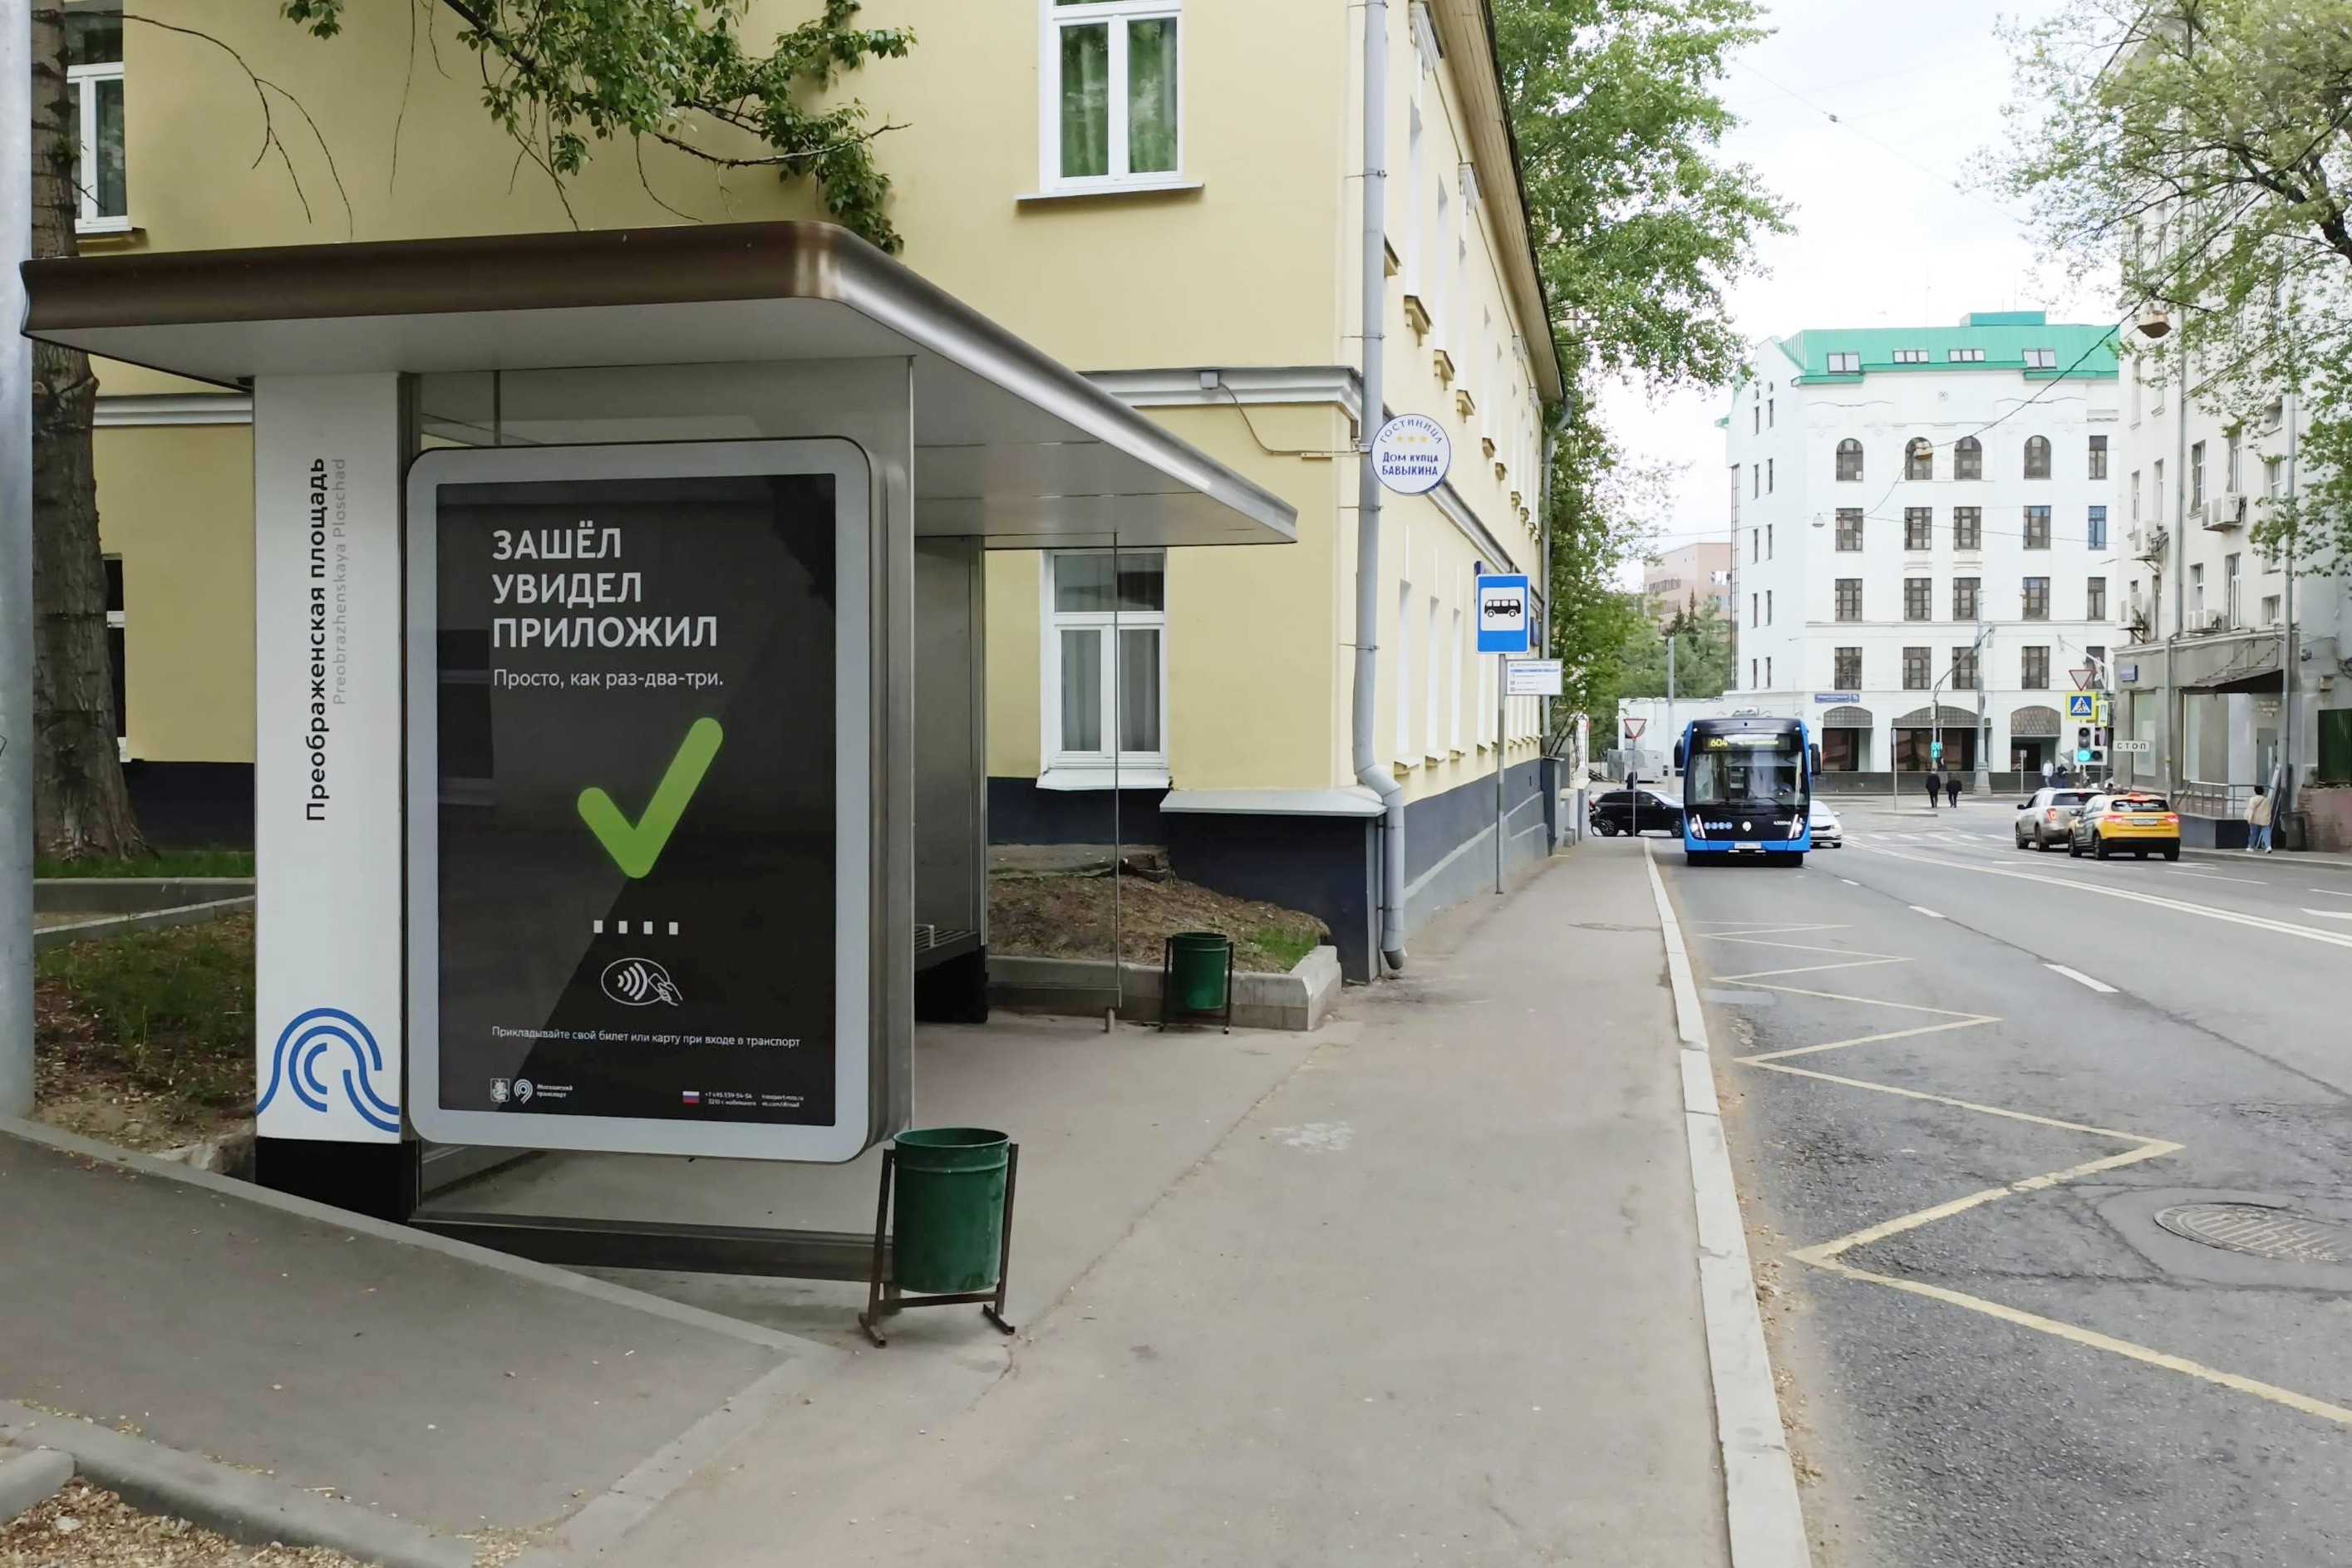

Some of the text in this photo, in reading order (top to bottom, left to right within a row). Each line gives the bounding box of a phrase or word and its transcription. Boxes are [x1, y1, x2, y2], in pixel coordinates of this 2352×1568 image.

[1380, 419, 1443, 444] ГОСТИНИЦА
[1382, 465, 1438, 476] БАВЫКИНА
[492, 520, 622, 561] ЗАШЁЛ
[331, 458, 349, 705] Preobrazhenskaya Ploschad
[492, 572, 642, 609] УВИДЕЛ
[306, 458, 330, 821] Преображенская площадь
[493, 616, 717, 648] ПРИЛОЖИЛ
[494, 669, 724, 691] Просто, как раз-два-три.
[492, 1025, 800, 1049] Прикладывайте свой билет или карту при входе в транспорт
